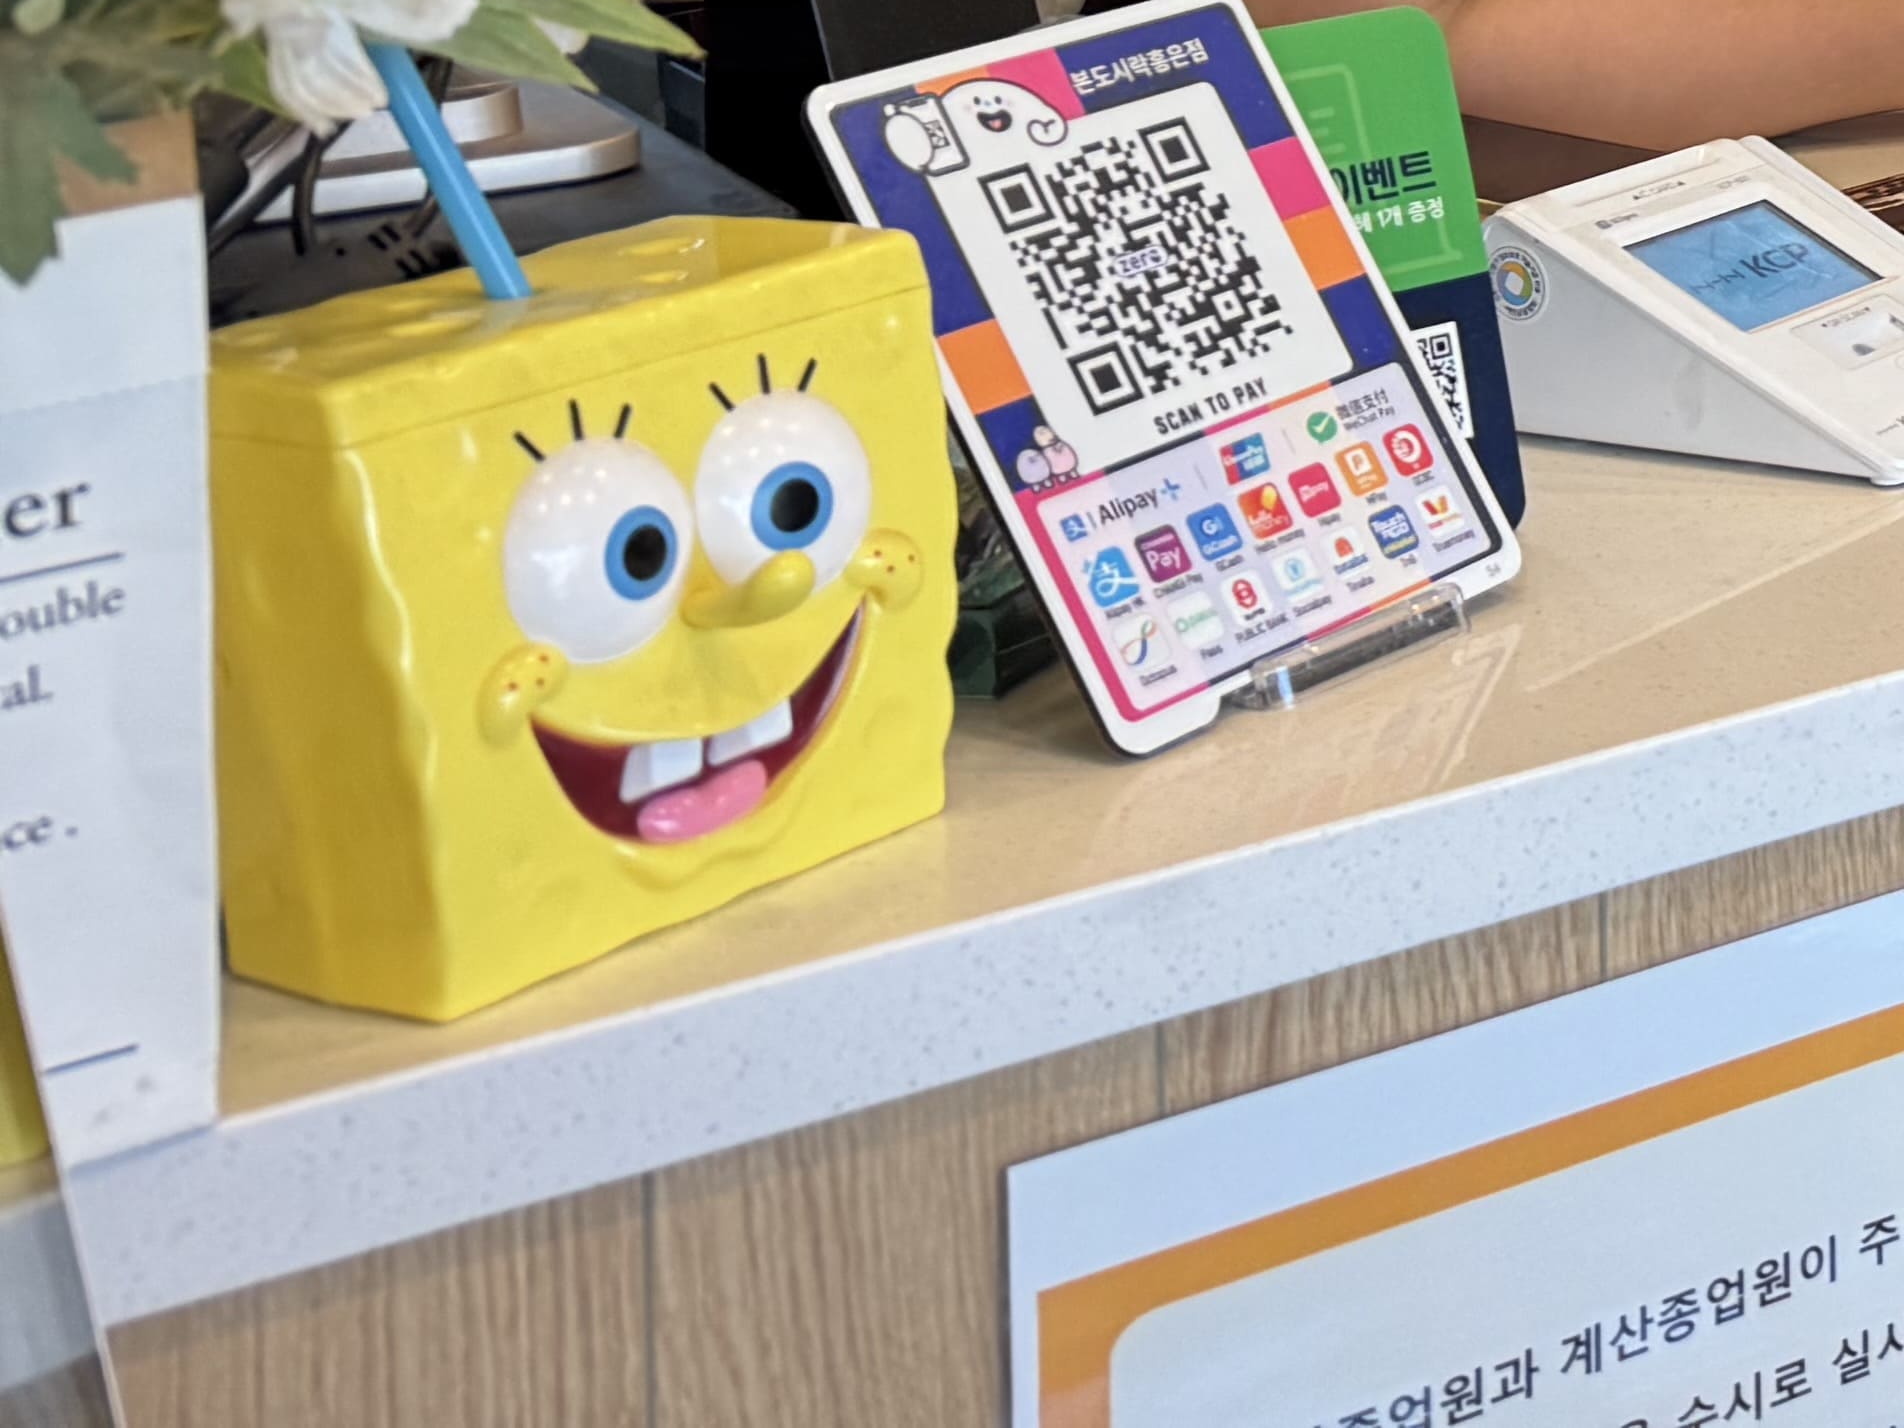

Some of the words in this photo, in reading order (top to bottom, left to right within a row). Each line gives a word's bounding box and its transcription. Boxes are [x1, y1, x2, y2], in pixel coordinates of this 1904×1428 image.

[1070, 38, 1209, 96] 본도시락홍은점
[1408, 196, 1445, 224] 증정
[1741, 242, 1810, 278] KCP
[1154, 402, 1204, 436] SCAN
[1204, 394, 1231, 416] TO
[1235, 377, 1269, 405] PAY
[1145, 546, 1182, 572] Pay
[1561, 1234, 1838, 1375] 계산종업원이
